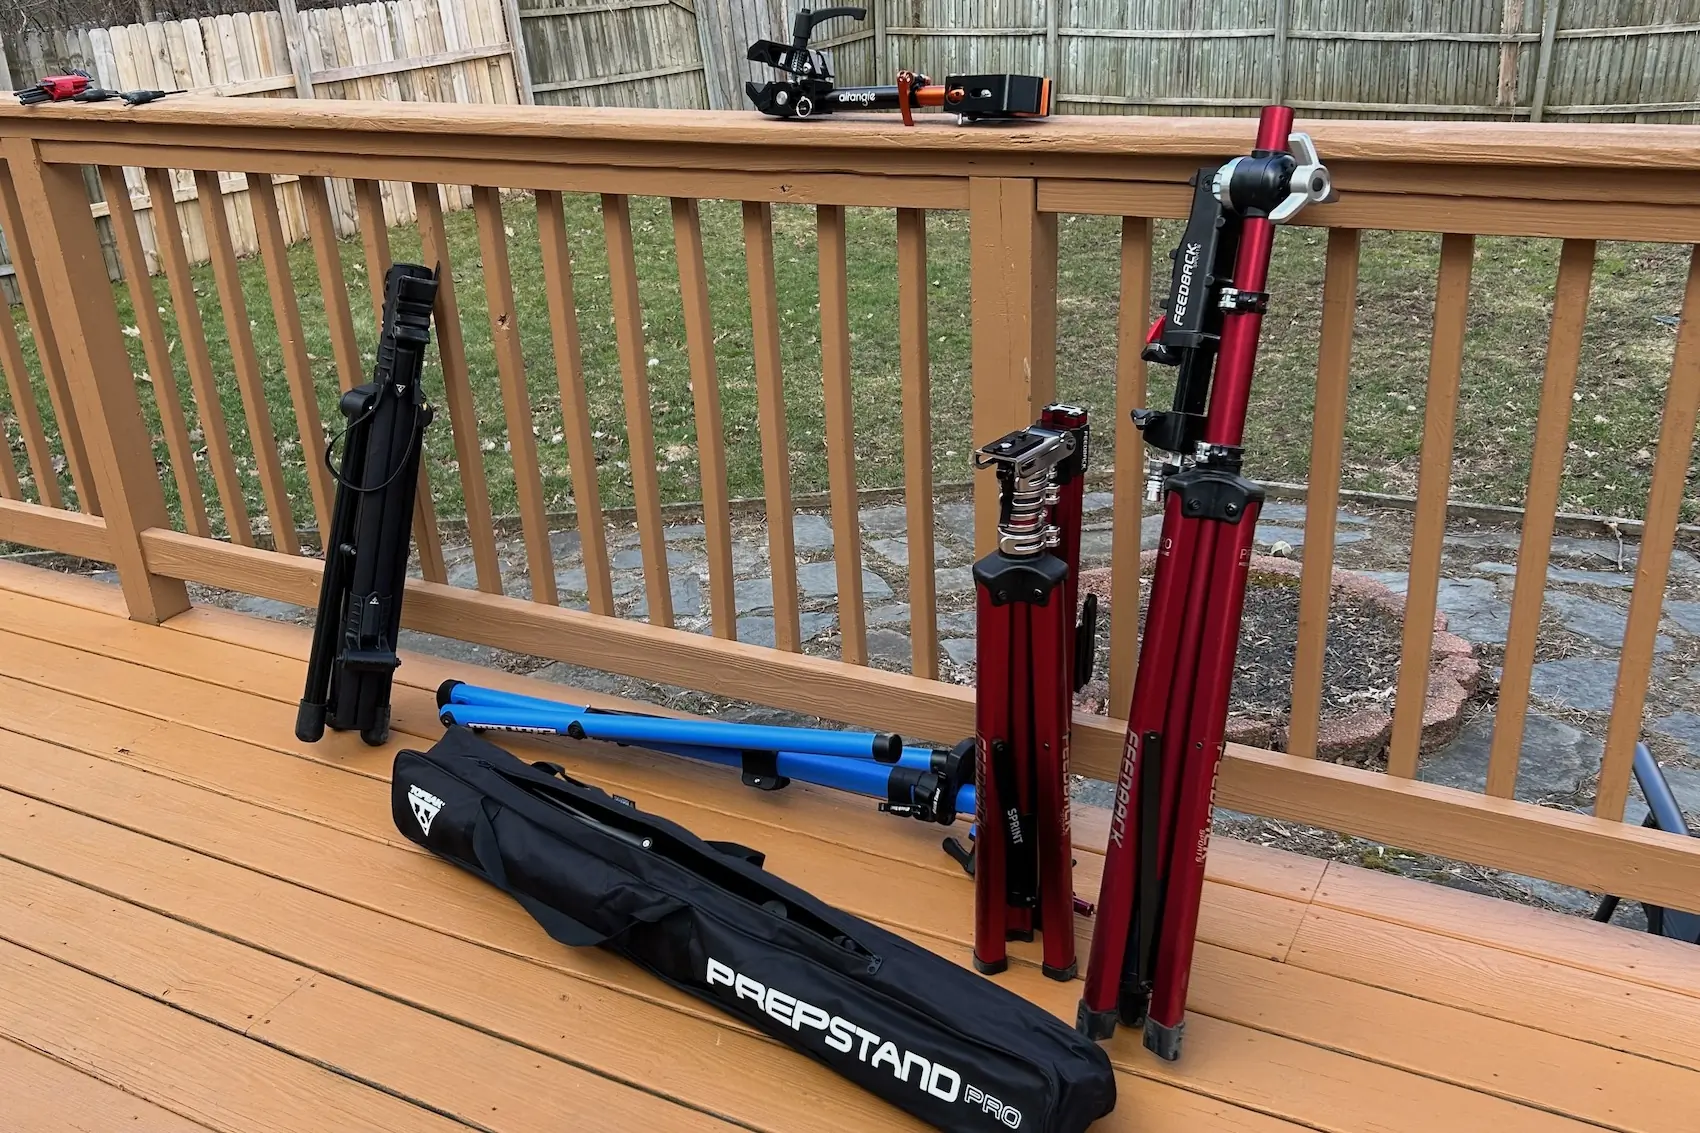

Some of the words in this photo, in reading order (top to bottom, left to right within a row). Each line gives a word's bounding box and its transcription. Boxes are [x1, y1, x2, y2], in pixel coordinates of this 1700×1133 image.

[838, 90, 876, 107] altangle
[1173, 243, 1198, 326] FEEDBACK
[1007, 808, 1023, 844] SPRINT
[706, 957, 961, 1103] PREPSTAND
[964, 1084, 1022, 1130] PRO
